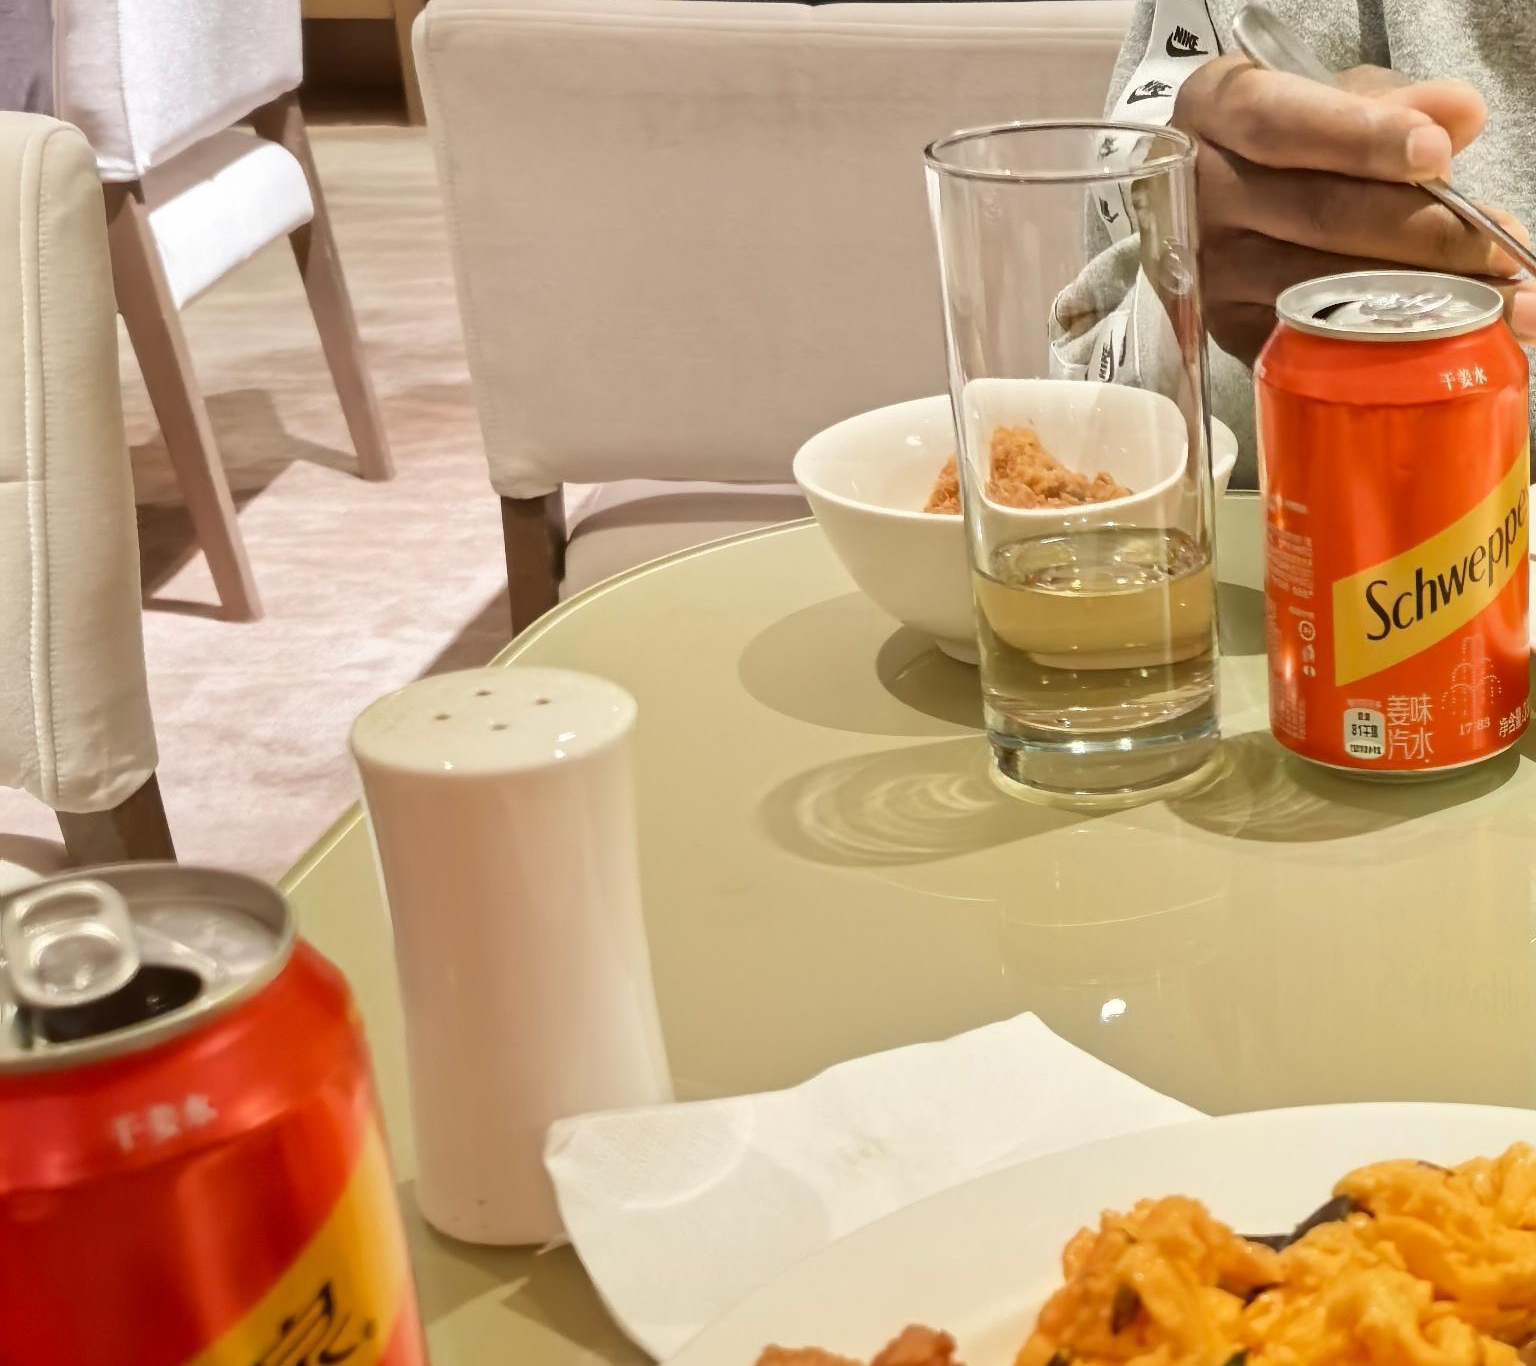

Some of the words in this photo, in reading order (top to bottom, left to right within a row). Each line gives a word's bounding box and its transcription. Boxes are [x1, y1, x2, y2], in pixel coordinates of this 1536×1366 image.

[1173, 25, 1199, 50] NIKE
[1386, 693, 1434, 727] 姜味
[1387, 725, 1436, 760] 汽水
